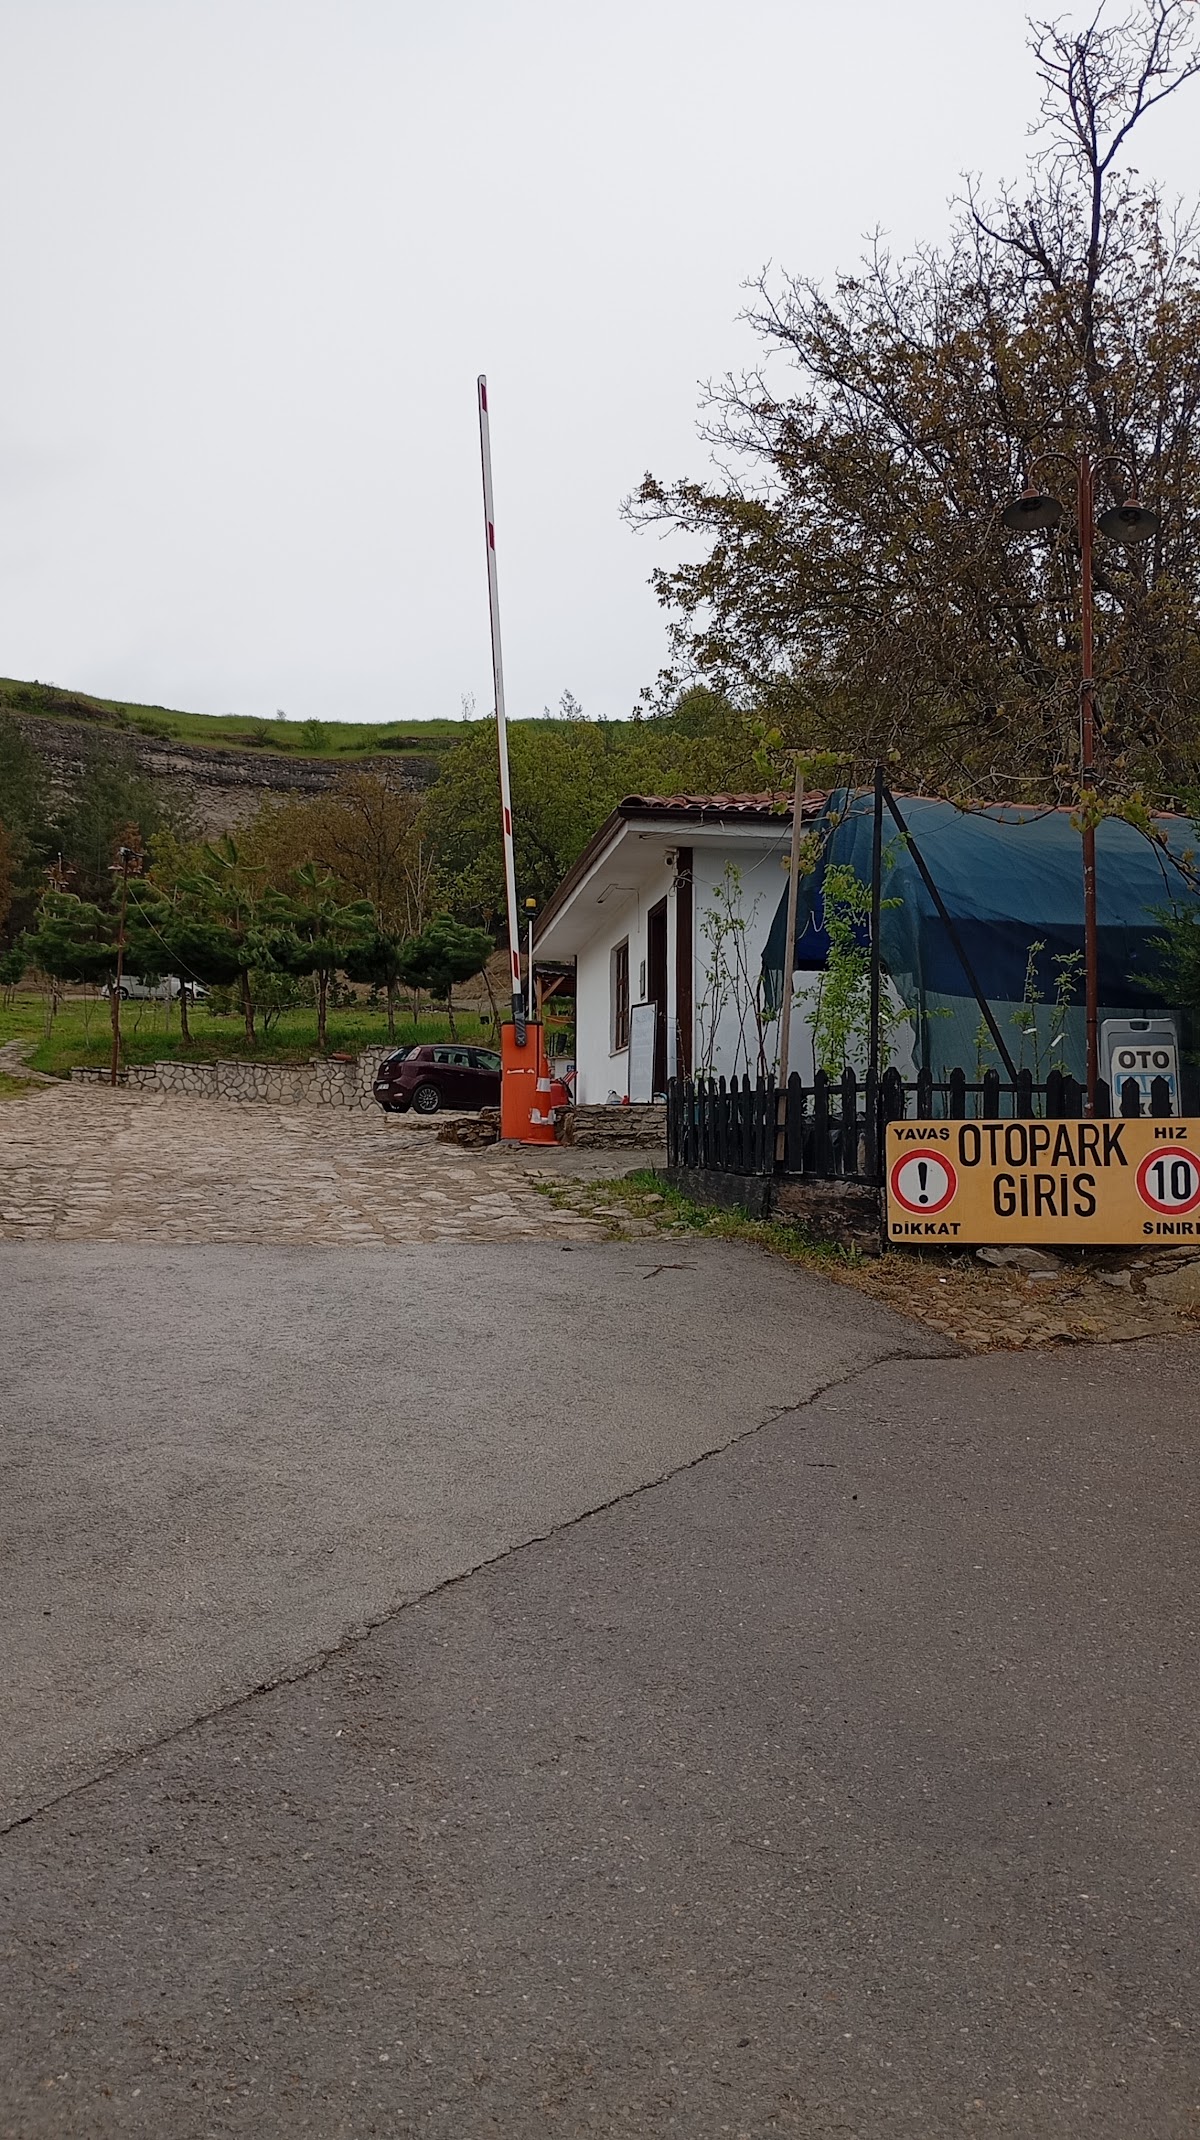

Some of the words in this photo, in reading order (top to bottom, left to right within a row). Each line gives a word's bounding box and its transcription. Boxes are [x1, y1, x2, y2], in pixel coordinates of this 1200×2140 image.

[1118, 1051, 1170, 1069] OTO
[1154, 1127, 1188, 1139] HIZ
[958, 1123, 1128, 1167] OTOPARK
[1151, 1161, 1192, 1200] 10
[892, 1220, 961, 1235] DİKKAT
